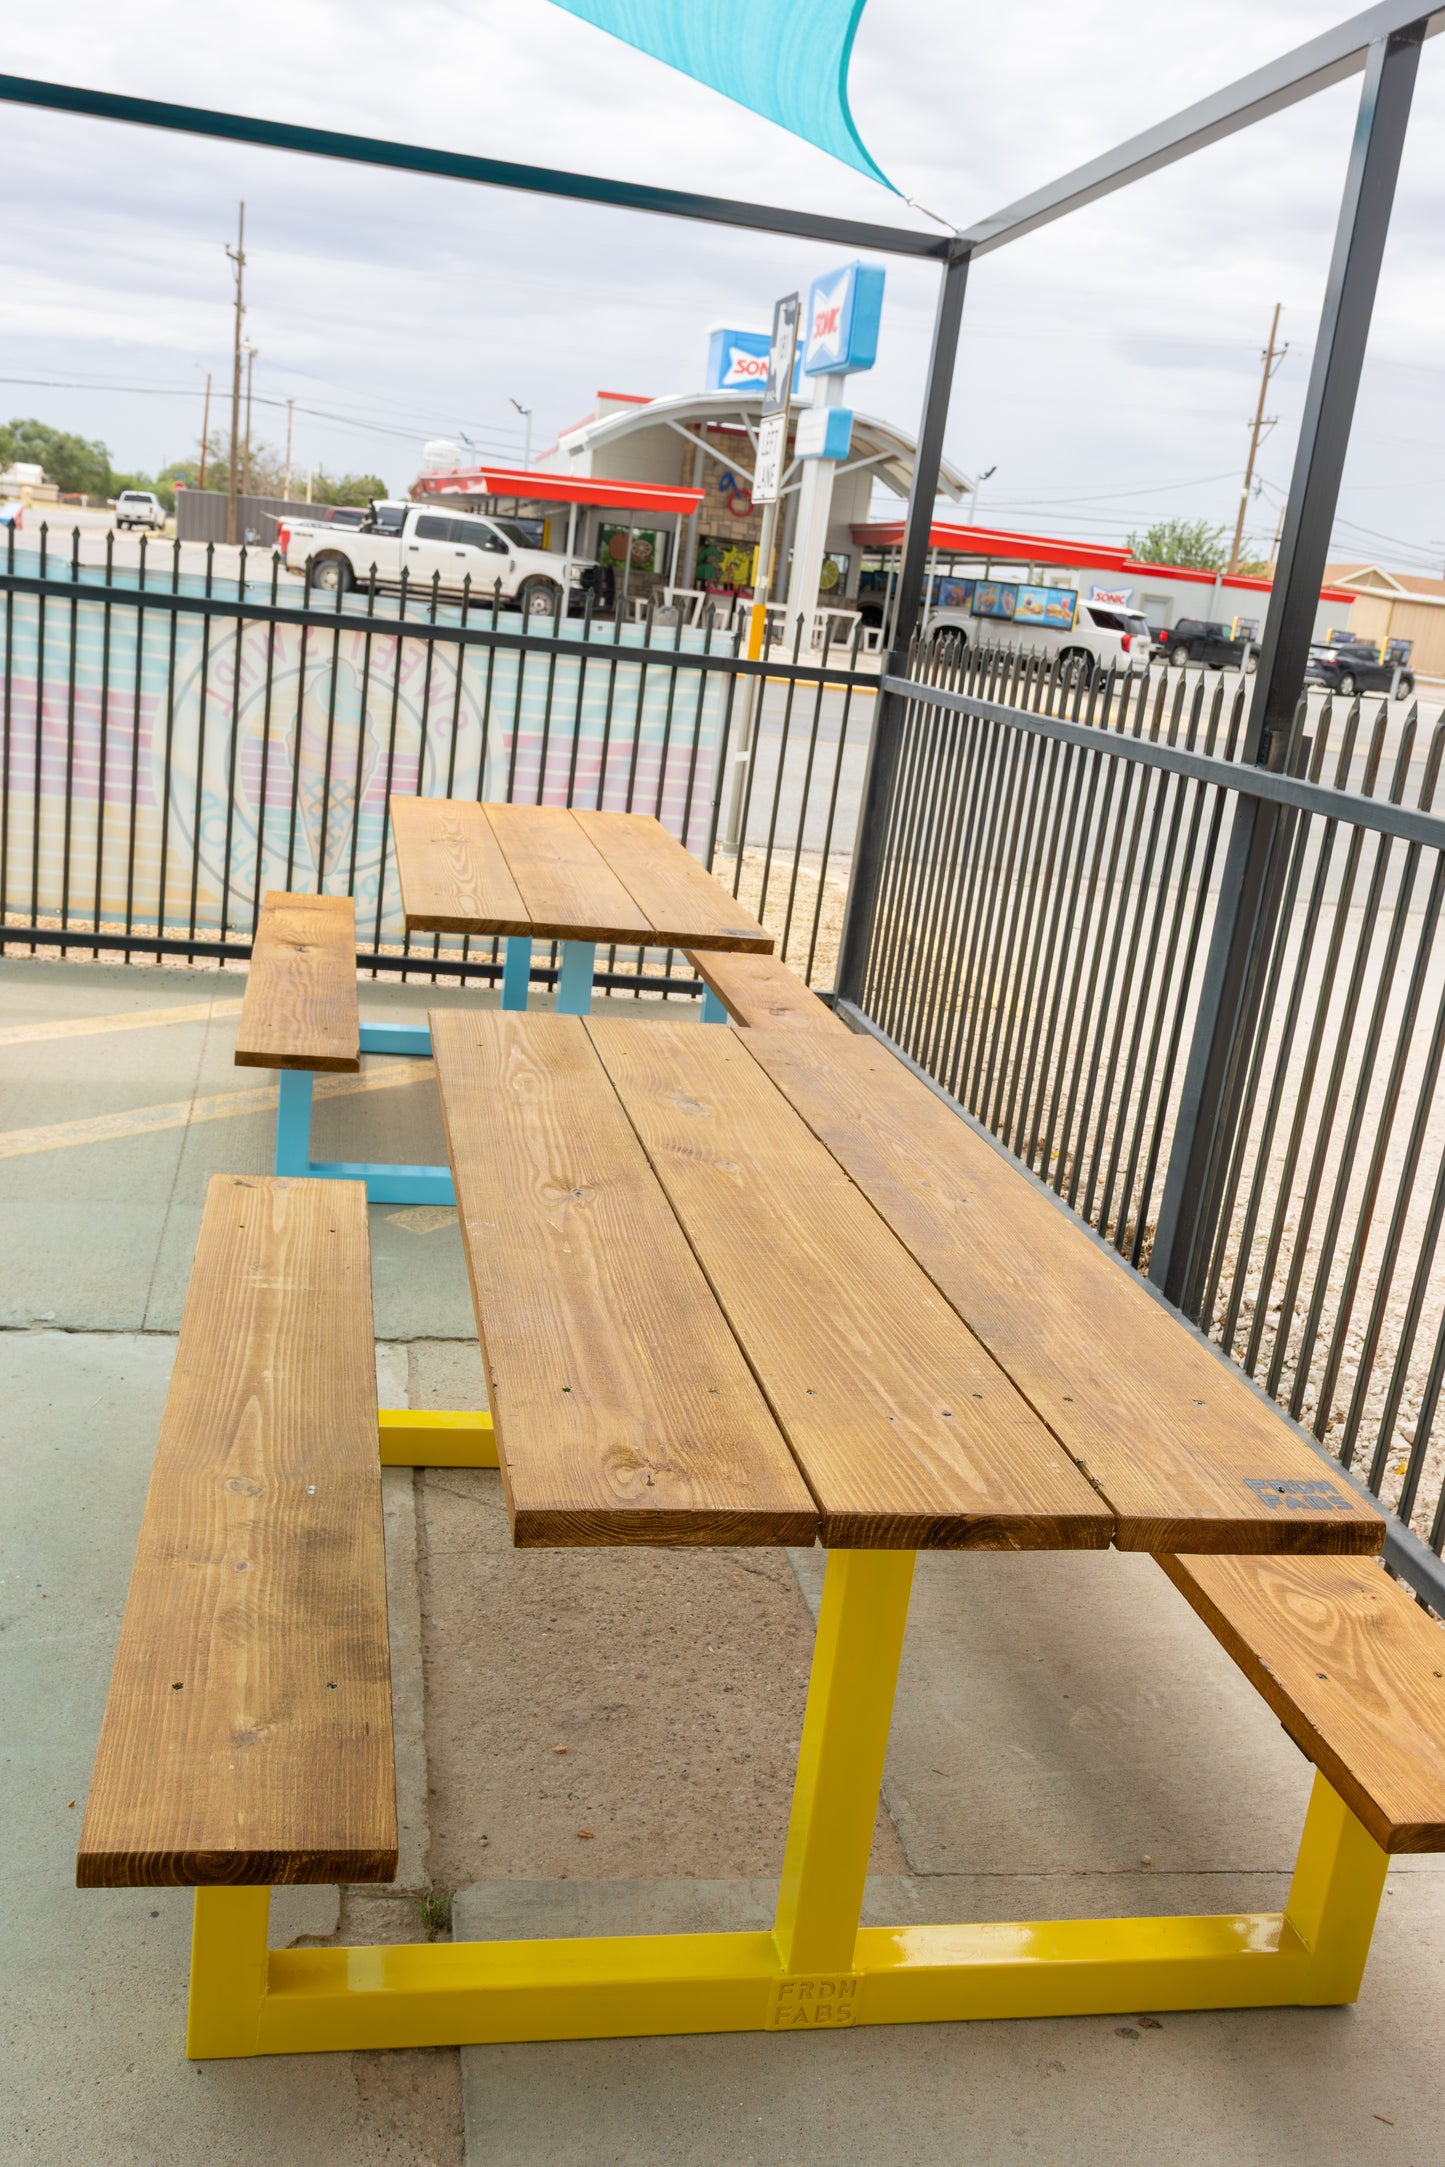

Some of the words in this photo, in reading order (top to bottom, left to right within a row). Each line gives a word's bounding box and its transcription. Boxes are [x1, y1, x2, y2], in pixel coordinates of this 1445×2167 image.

[1095, 592, 1126, 605] SONIC
[777, 1979, 857, 2002] FRDM
[774, 2002, 853, 2026] FABS
